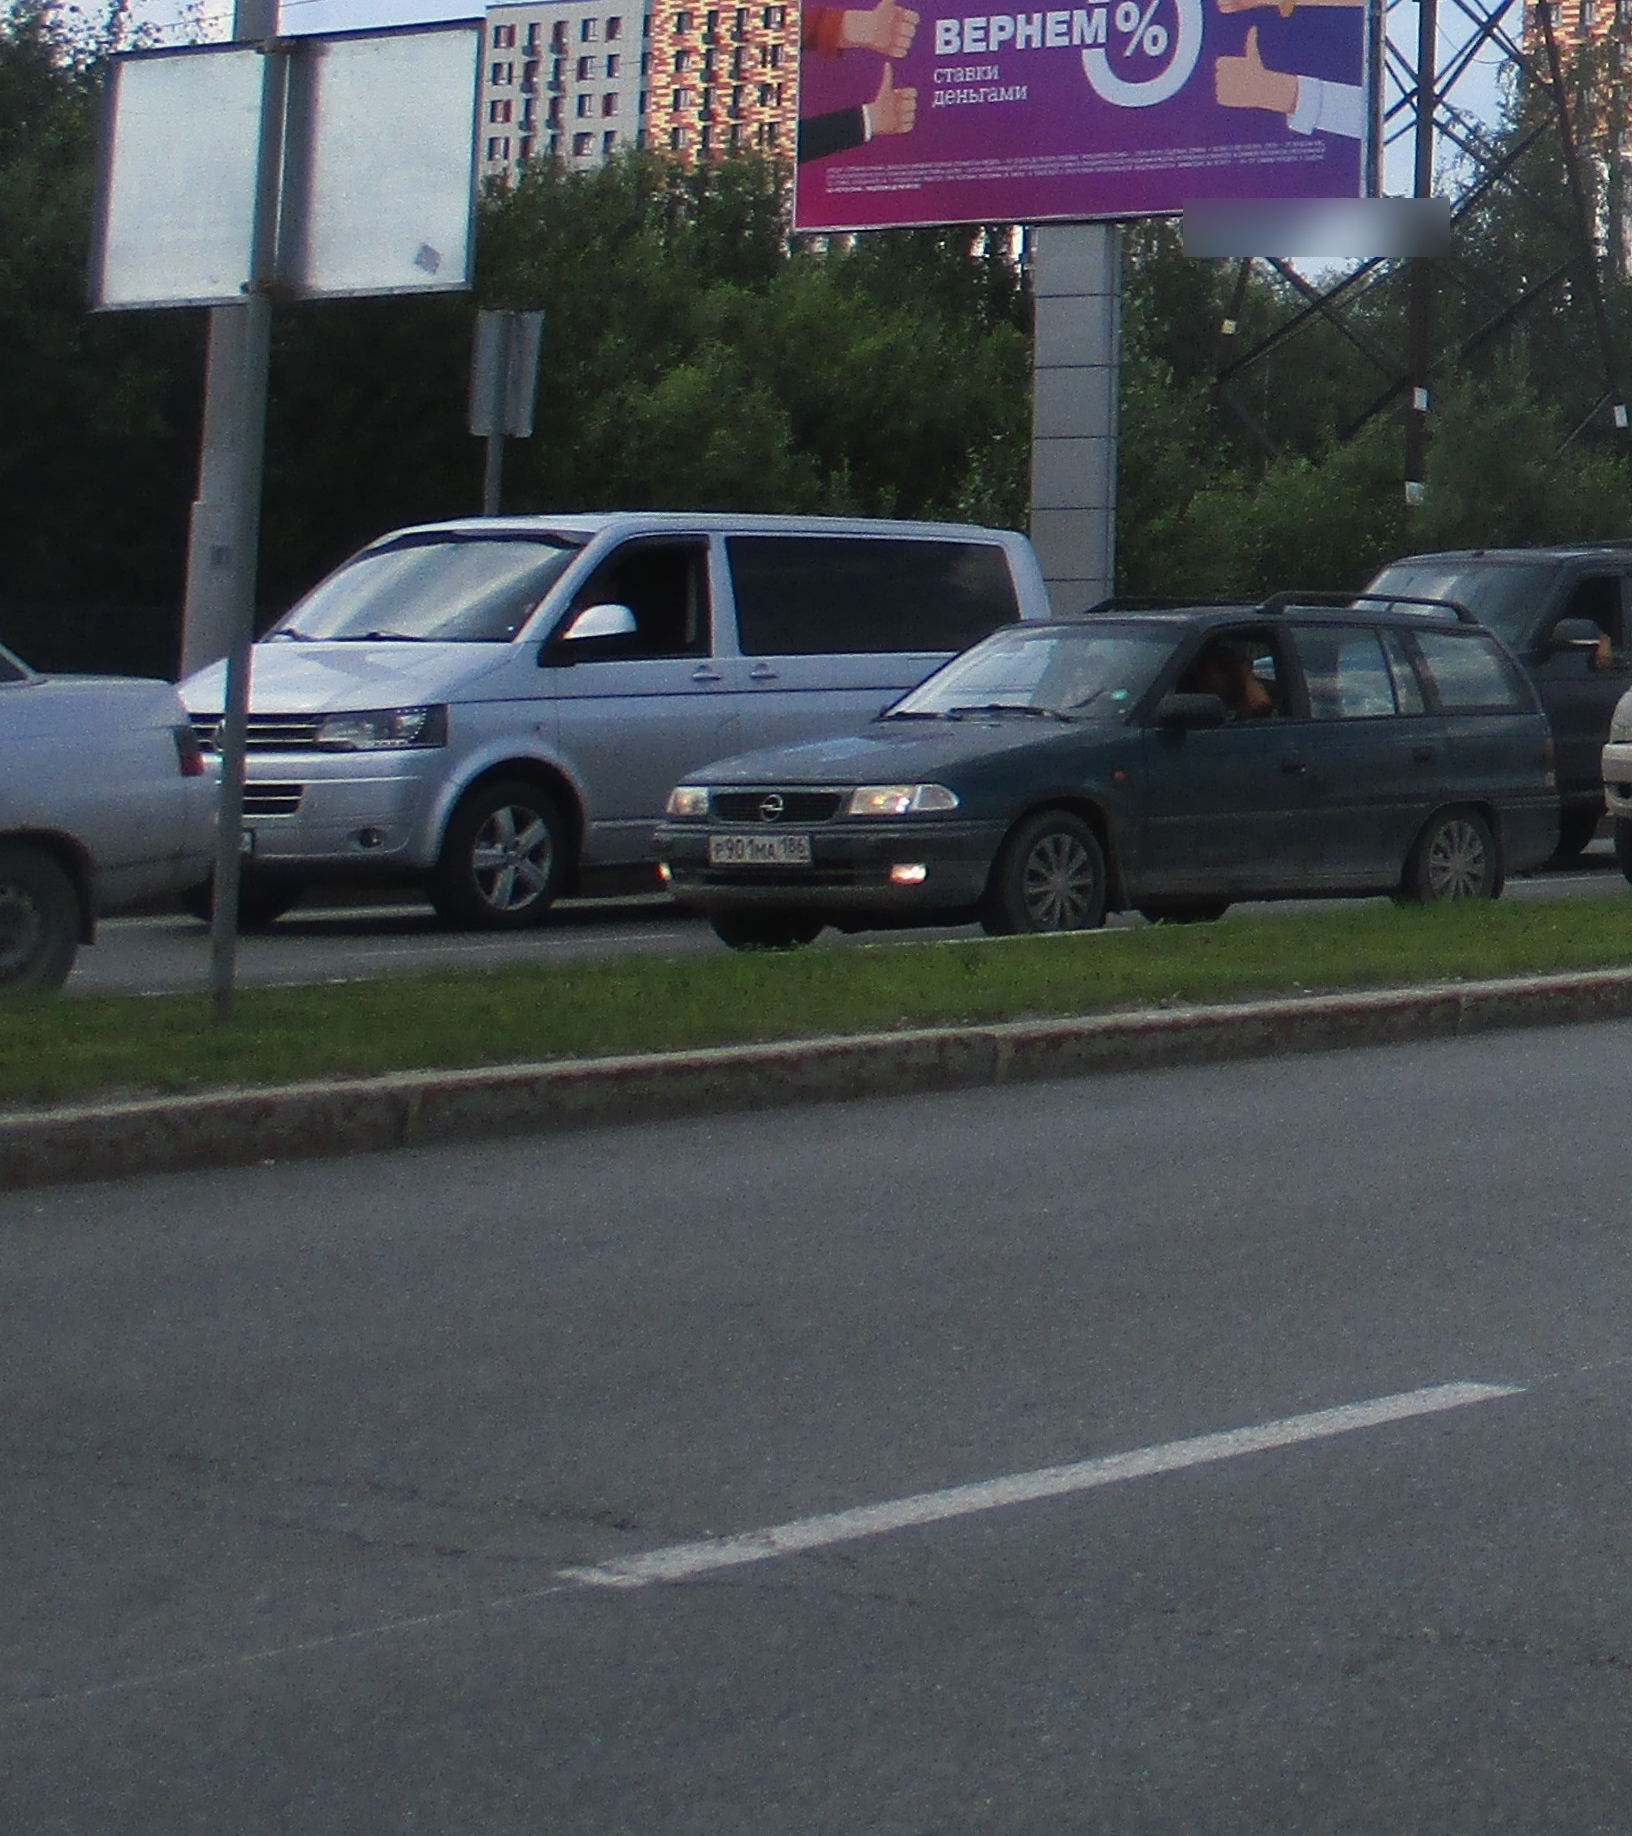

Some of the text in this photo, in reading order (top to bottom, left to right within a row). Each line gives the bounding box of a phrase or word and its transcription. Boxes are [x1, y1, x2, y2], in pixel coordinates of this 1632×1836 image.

[935, 7, 1108, 55] ВЕРНЕМ
[933, 64, 999, 83] ставки
[932, 84, 1028, 108] деньгами
